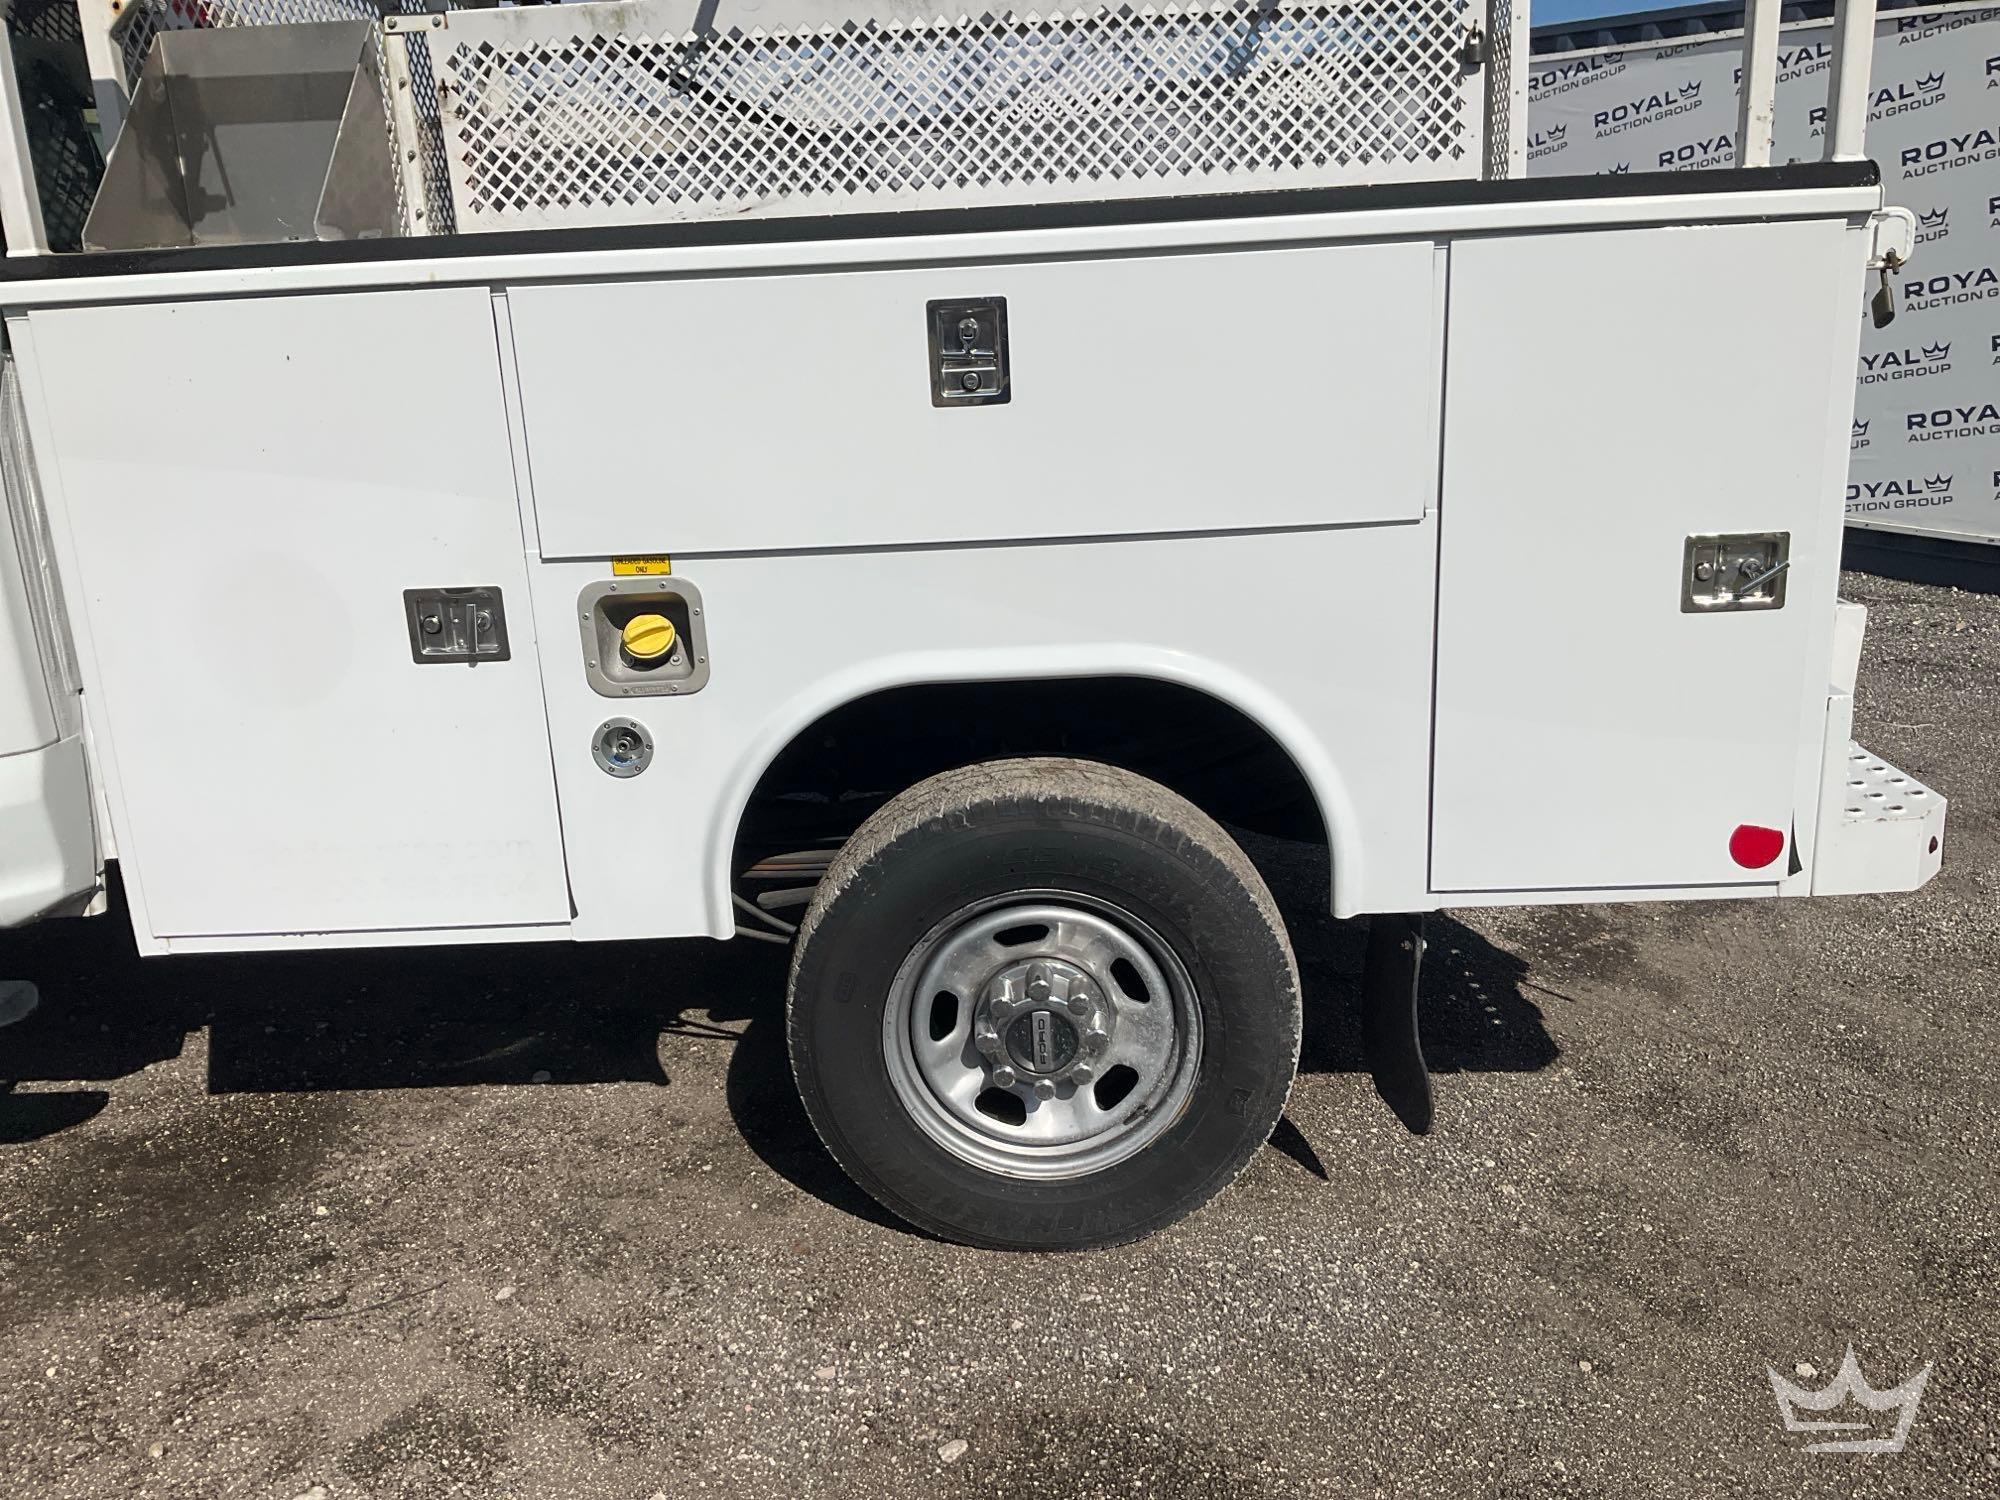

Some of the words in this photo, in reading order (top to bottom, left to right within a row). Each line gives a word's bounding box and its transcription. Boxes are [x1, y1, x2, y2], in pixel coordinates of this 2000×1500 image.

[1899, 15, 1976, 46] AUCTION
[1528, 56, 1603, 93] ROYAL
[1528, 80, 1579, 103] AUCTION
[1581, 64, 1626, 87] GROUP
[1594, 91, 1678, 128] ROYAL
[1595, 115, 1652, 139] AUCTION
[1655, 100, 1702, 121] GROUP
[1886, 93, 1946, 117] GROUP
[1659, 131, 1738, 167] ROYA
[1901, 127, 2000, 167] ROYA
[1902, 153, 1980, 180] AUCTION
[1905, 290, 1983, 313] AUCTION
[1856, 372, 1888, 385] ION
[1891, 364, 1952, 381] GROUP
[1908, 425, 1985, 443] AUCTION
[1894, 495, 1953, 509] GROUP
[635, 565, 648, 573] ONLY
[1037, 1018, 1048, 1065] FORD
